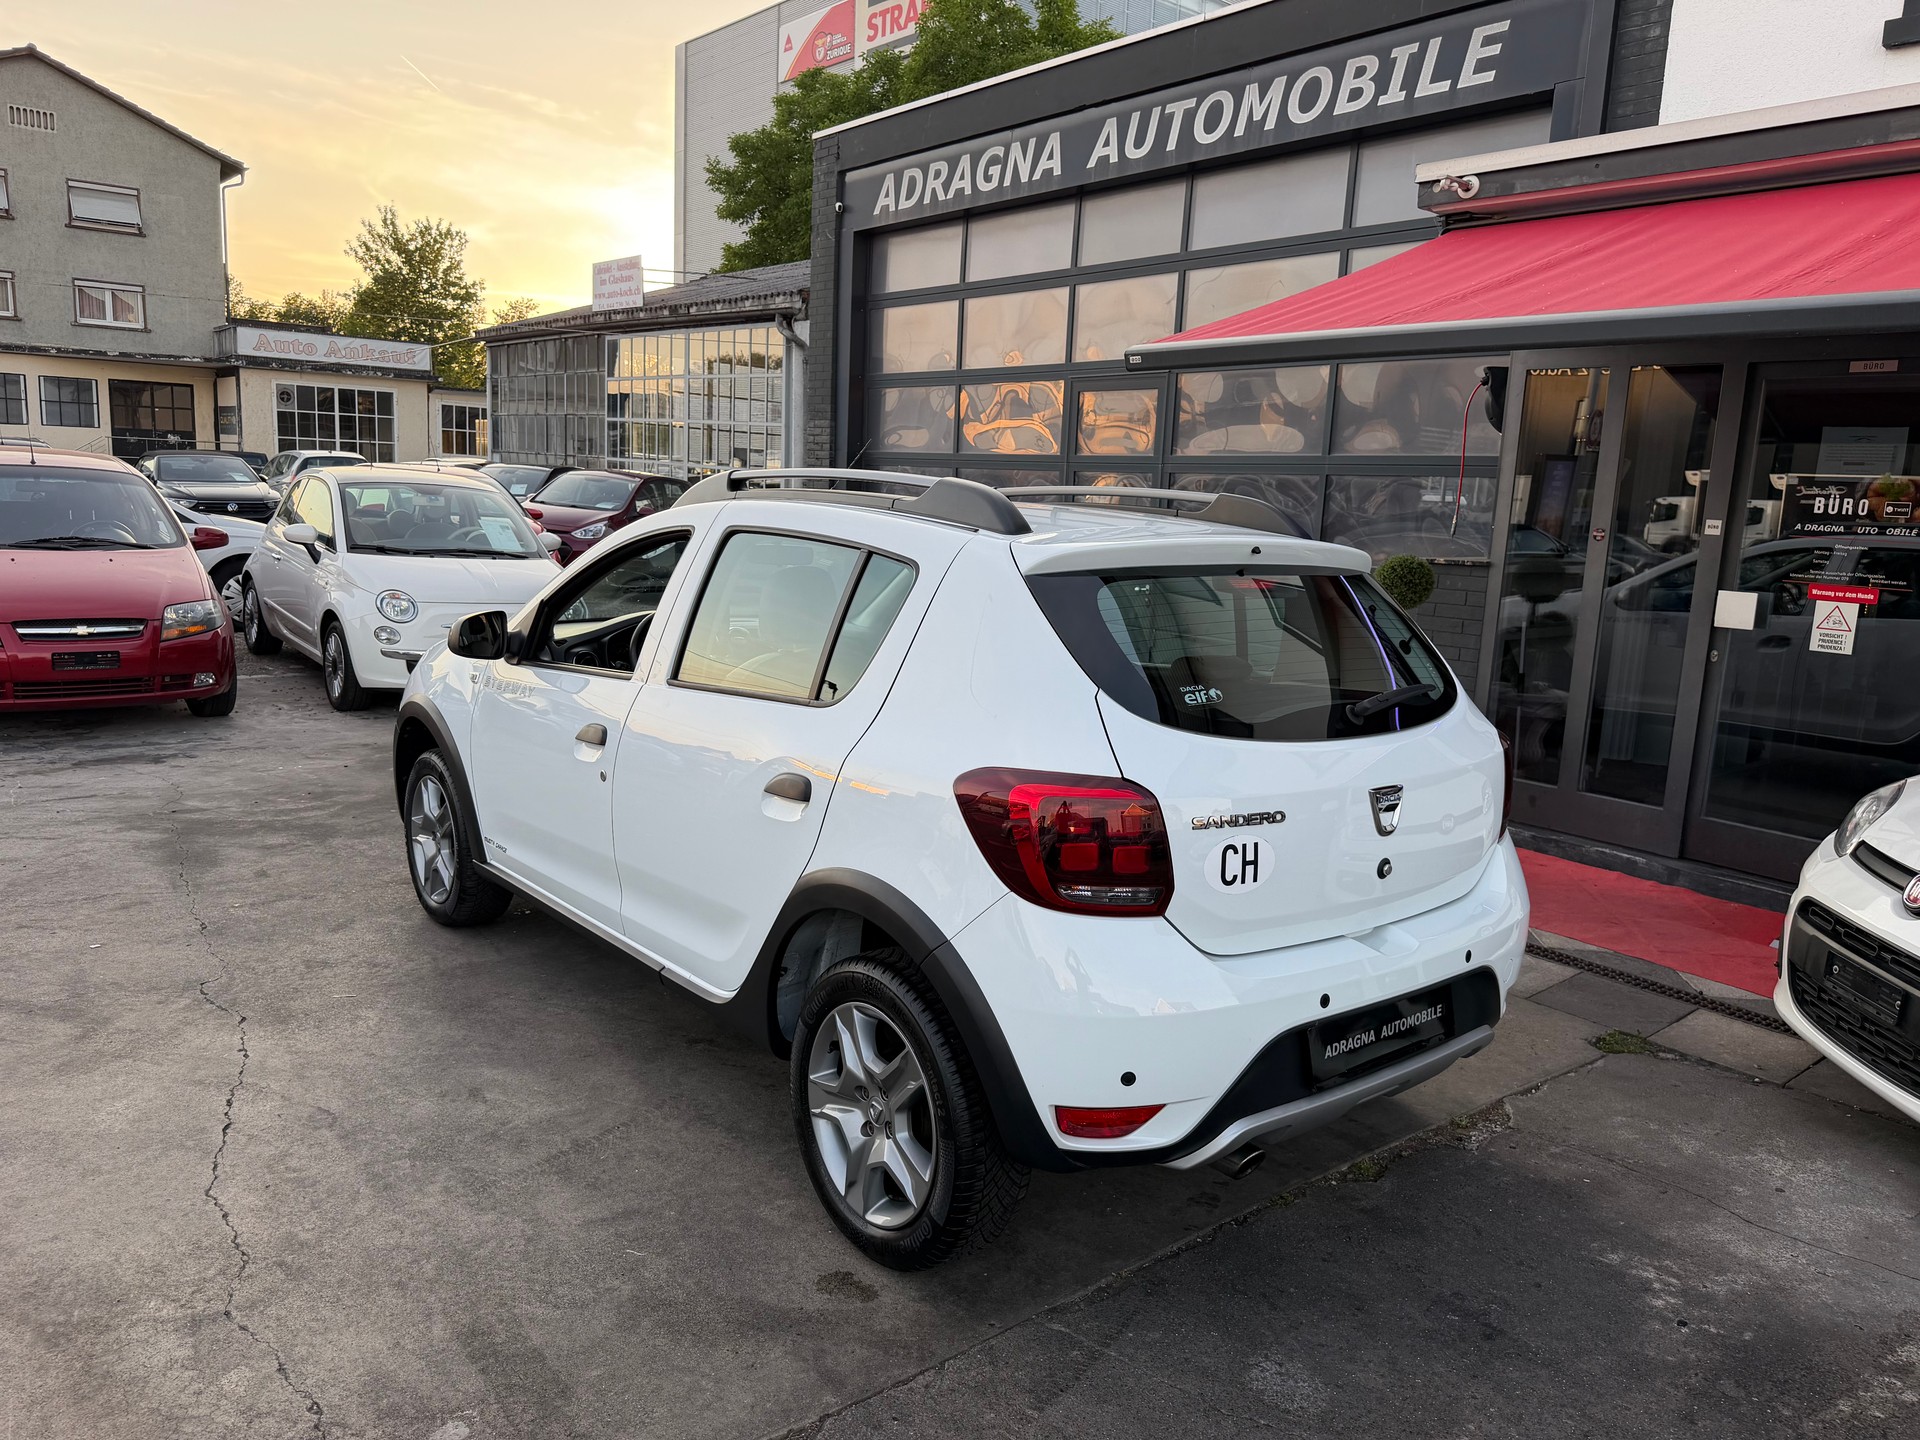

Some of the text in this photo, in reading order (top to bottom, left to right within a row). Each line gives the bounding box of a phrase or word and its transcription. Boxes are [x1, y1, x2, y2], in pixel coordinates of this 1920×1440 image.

[866, 0, 928, 42] STRA
[826, 44, 851, 60] ZURIQUE
[873, 20, 1512, 216] ADRAGNA AUTOMOBILE
[608, 274, 634, 285] Glashaus
[253, 334, 417, 365] Auto Ankauf
[1863, 362, 1885, 370] BÜRO
[1814, 494, 1869, 516] BÜRO
[1812, 589, 1834, 597] Warnung
[484, 676, 536, 698] STEPWAY
[1184, 691, 1208, 704] elf
[1379, 794, 1402, 804] DACIA
[1191, 810, 1286, 830] SANDERO
[1220, 842, 1258, 886] CH
[1324, 1004, 1442, 1060] ADRAGNA AUTOMOBILE
